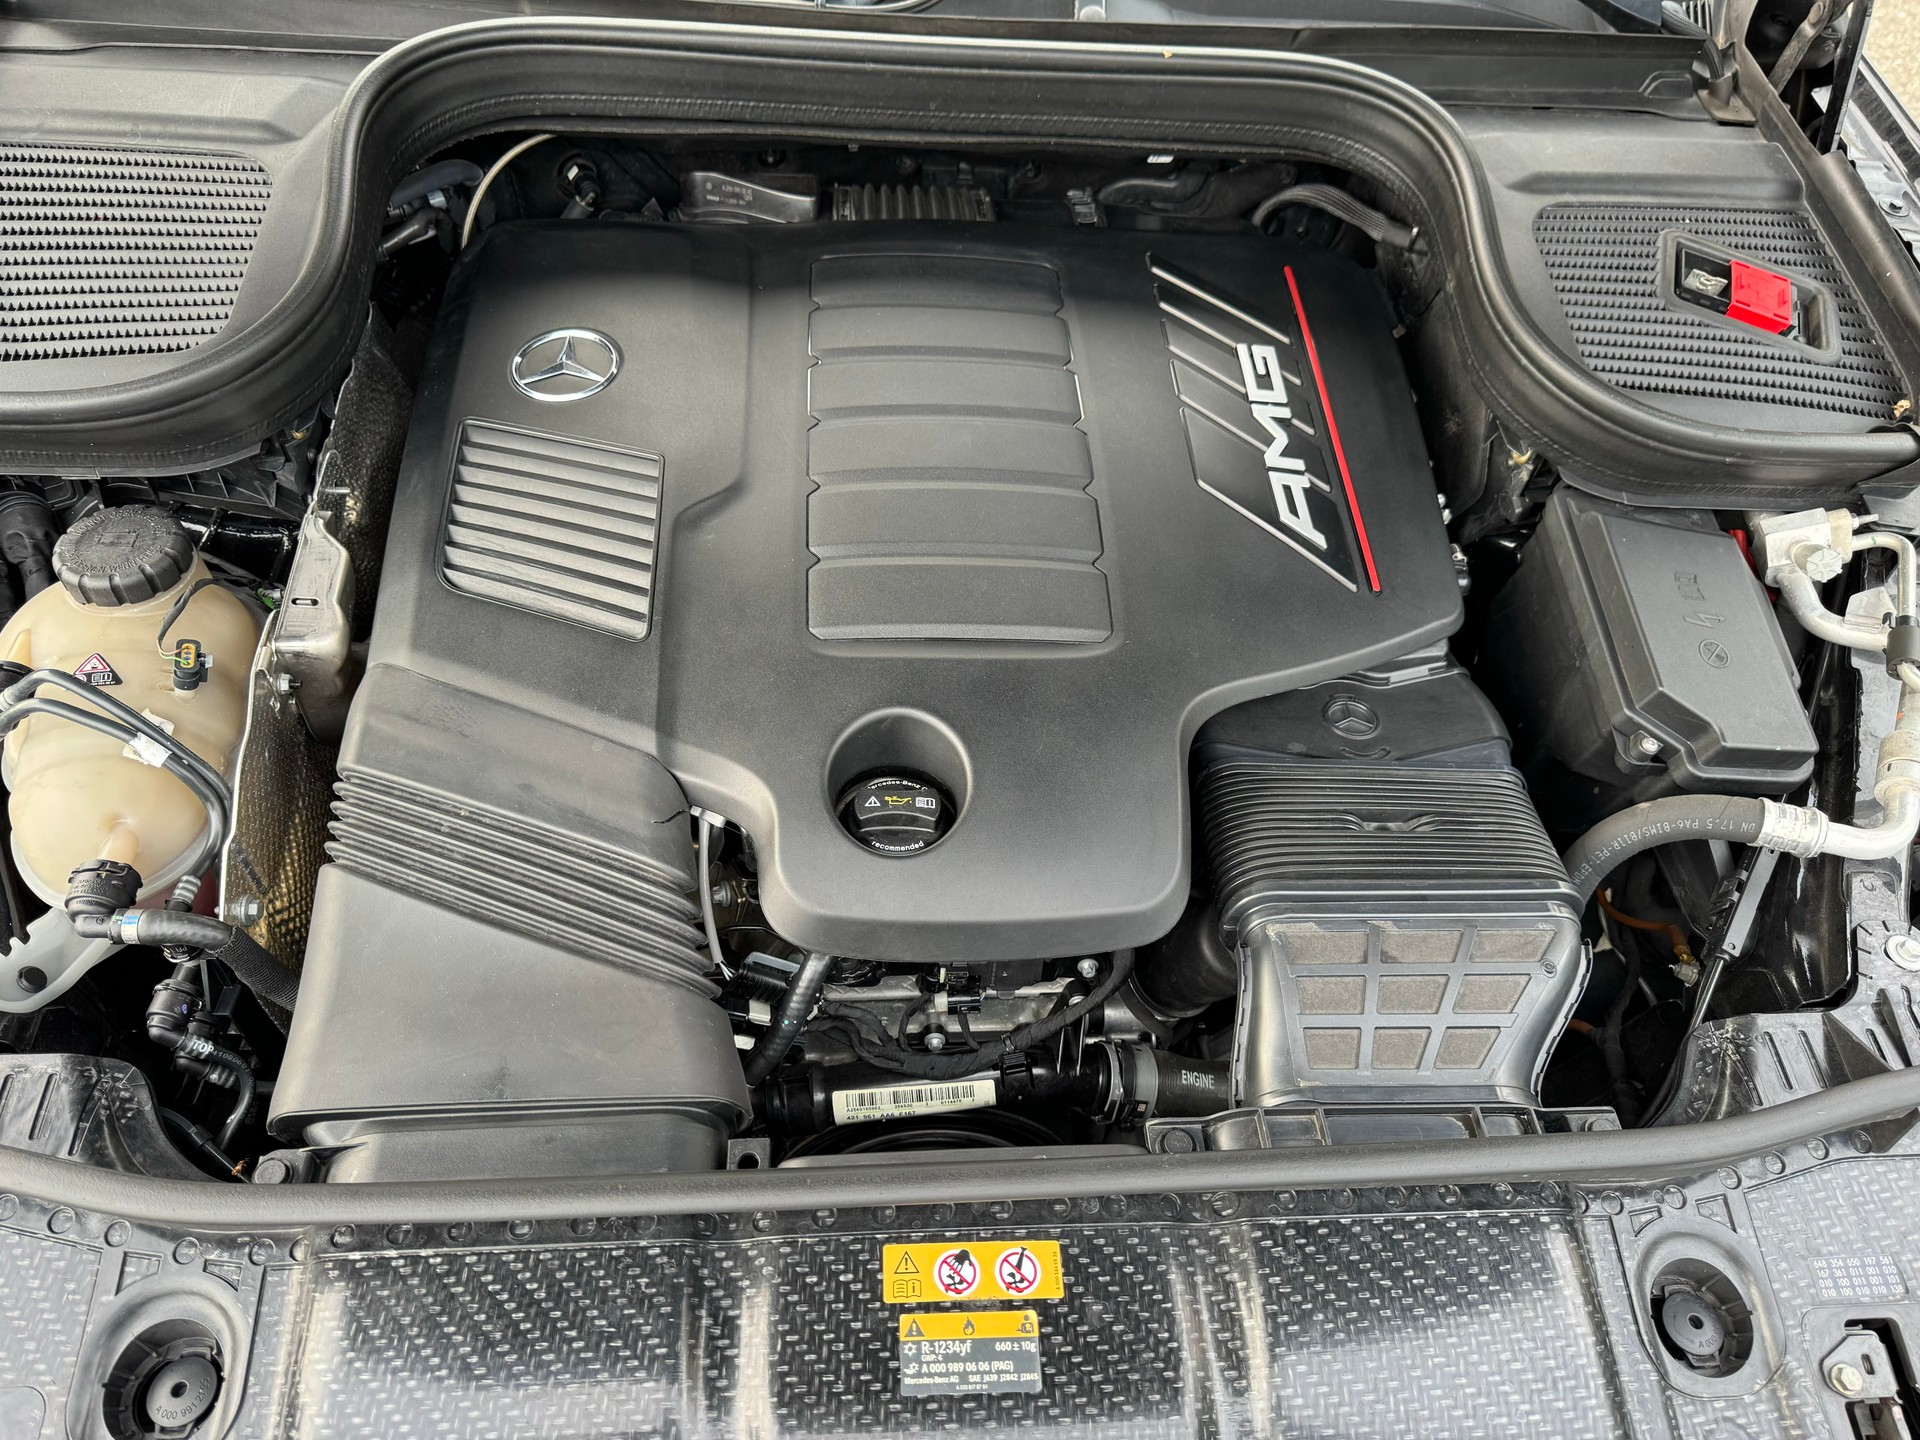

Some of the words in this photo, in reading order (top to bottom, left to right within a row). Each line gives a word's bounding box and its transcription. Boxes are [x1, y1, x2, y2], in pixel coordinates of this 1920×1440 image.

[1236, 343, 1328, 550] AMG
[1740, 822, 1756, 833] DN
[871, 840, 925, 853] recommended
[193, 1040, 215, 1056] TOP
[1181, 1069, 1215, 1090] ENGINE
[1813, 1259, 1827, 1268] 648
[1830, 1258, 1844, 1267] 354
[1847, 1257, 1861, 1266] 650
[1863, 1256, 1876, 1265] 197
[1880, 1255, 1893, 1264] 561
[1816, 1269, 1829, 1278] 167
[1832, 1268, 1846, 1277] 361
[1849, 1267, 1863, 1276] 011
[1866, 1266, 1880, 1275] 001
[1882, 1265, 1897, 1274] 010
[1819, 1278, 1833, 1288] 010
[1836, 1277, 1850, 1287] 100
[1852, 1276, 1866, 1286] 011
[1869, 1275, 1883, 1285] 001
[1886, 1274, 1900, 1284] 101
[1822, 1288, 1836, 1297] 010
[1839, 1287, 1853, 1296] 100
[1855, 1286, 1870, 1295] 010
[1872, 1285, 1887, 1294] 010
[1890, 1284, 1904, 1293] 138
[921, 1340, 972, 1356] R-1234yf
[995, 1341, 1012, 1351] 660
[1020, 1340, 1037, 1353] 10g
[1698, 1340, 1705, 1349] A
[1704, 1334, 1717, 1348] 000
[921, 1363, 929, 1373] A
[929, 1362, 946, 1373] 000
[947, 1362, 964, 1373] 989
[965, 1361, 977, 1372] 06
[978, 1361, 990, 1372] 06
[991, 1360, 1014, 1373] (PAG)
[904, 1376, 949, 1385] Mercedes-Benz
[950, 1375, 960, 1383] AG
[968, 1374, 982, 1383] SAE
[983, 1373, 998, 1383] J639
[1000, 1373, 1018, 1382] J2842
[1020, 1372, 1039, 1382] J2845
[155, 1405, 163, 1415] A
[161, 1409, 178, 1420] 000
[180, 1402, 198, 1417] 991
